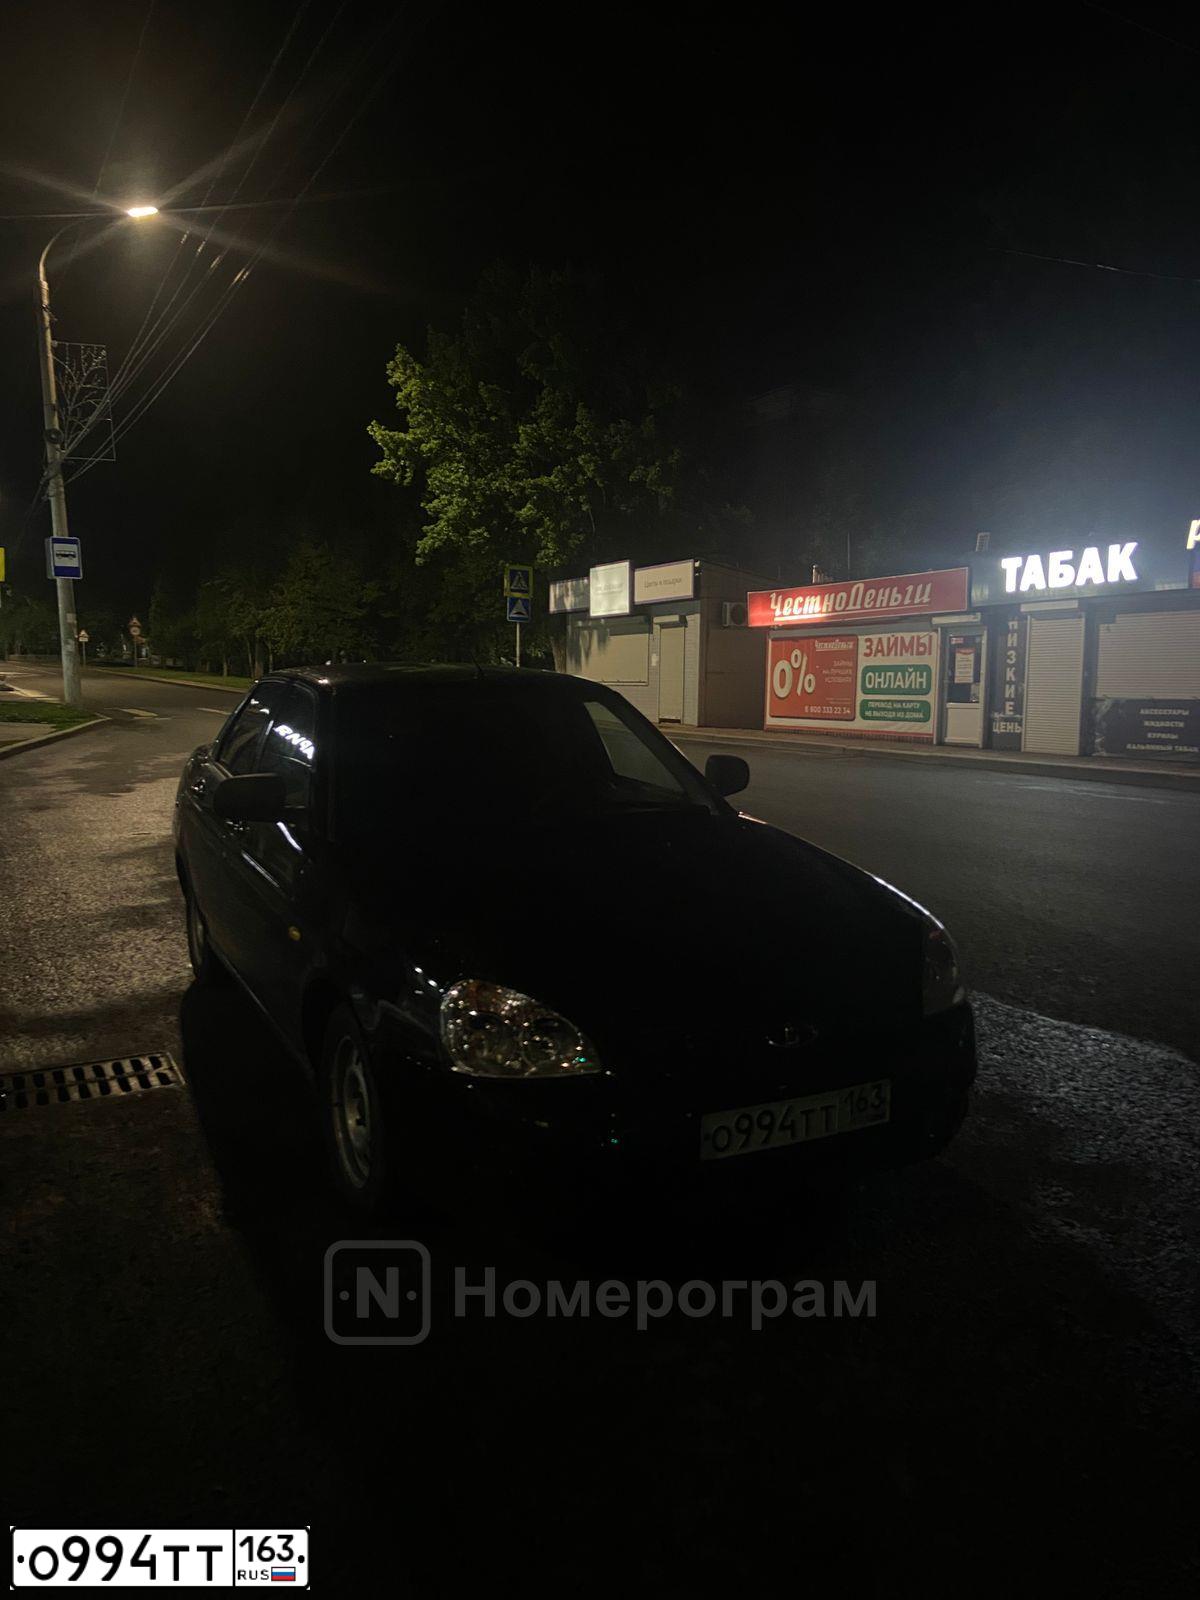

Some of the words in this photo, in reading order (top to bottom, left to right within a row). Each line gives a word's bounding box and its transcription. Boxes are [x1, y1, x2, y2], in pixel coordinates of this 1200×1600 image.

[1001, 542, 1139, 593] ТАБАК
[769, 582, 933, 617] ЧестноДеньги
[863, 634, 932, 658] ЗАЙМЫ
[773, 648, 816, 698] 0%
[865, 666, 927, 689] ОНЛАЙН
